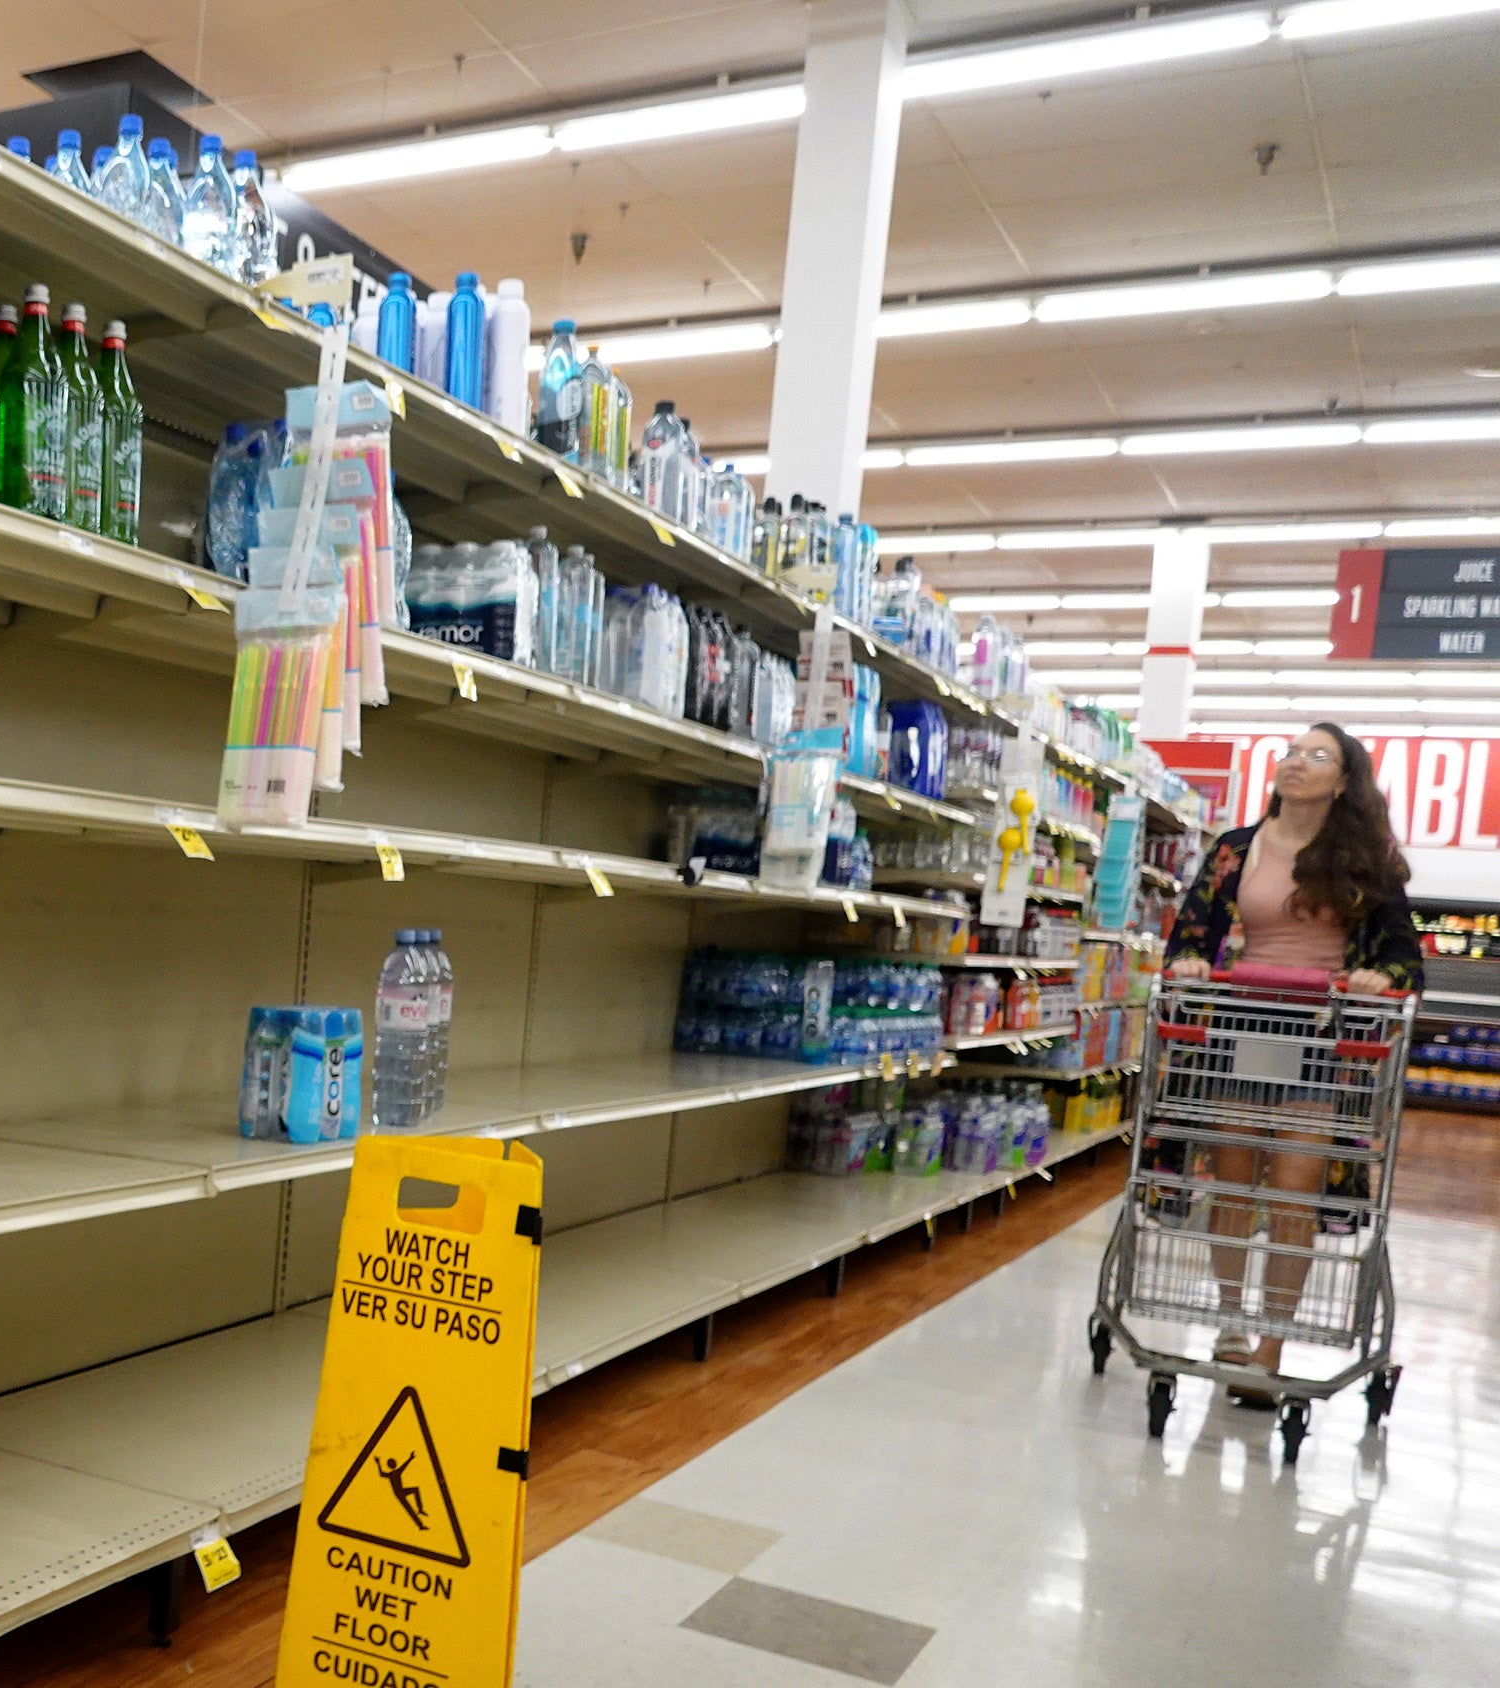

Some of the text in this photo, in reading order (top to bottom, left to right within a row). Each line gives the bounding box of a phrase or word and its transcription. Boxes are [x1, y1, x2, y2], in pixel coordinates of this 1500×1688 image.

[1351, 584, 1362, 623] 1
[1403, 594, 1477, 618] SPARKLING
[1439, 630, 1486, 653] WATER
[327, 1048, 343, 1116] core
[386, 1228, 469, 1269] WATCH
[358, 1252, 493, 1303] YOUR STEP
[342, 1287, 500, 1345] VER SU PASO
[327, 1546, 453, 1600] CAUTION
[355, 1586, 417, 1621] WET
[334, 1613, 430, 1661] FLOOR
